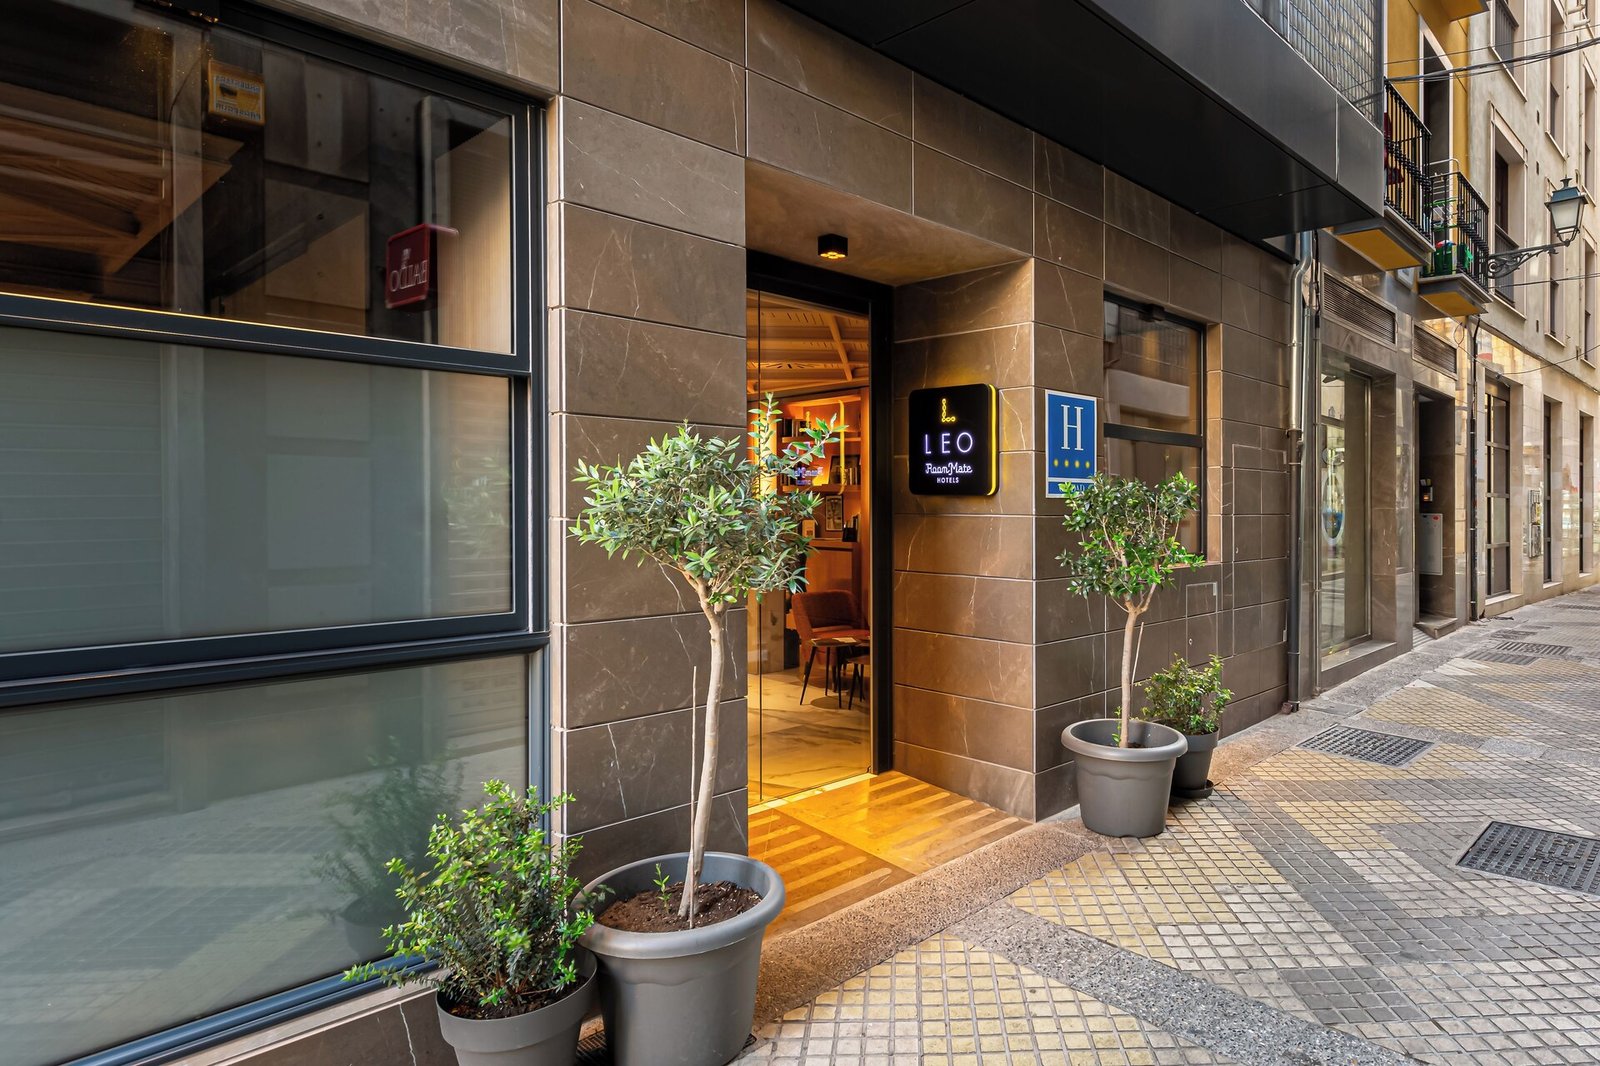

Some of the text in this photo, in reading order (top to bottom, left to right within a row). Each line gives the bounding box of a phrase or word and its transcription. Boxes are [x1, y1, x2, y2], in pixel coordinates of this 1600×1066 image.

[1061, 404, 1084, 451] H
[925, 432, 973, 454] LEO
[936, 476, 959, 484] HOTELS
